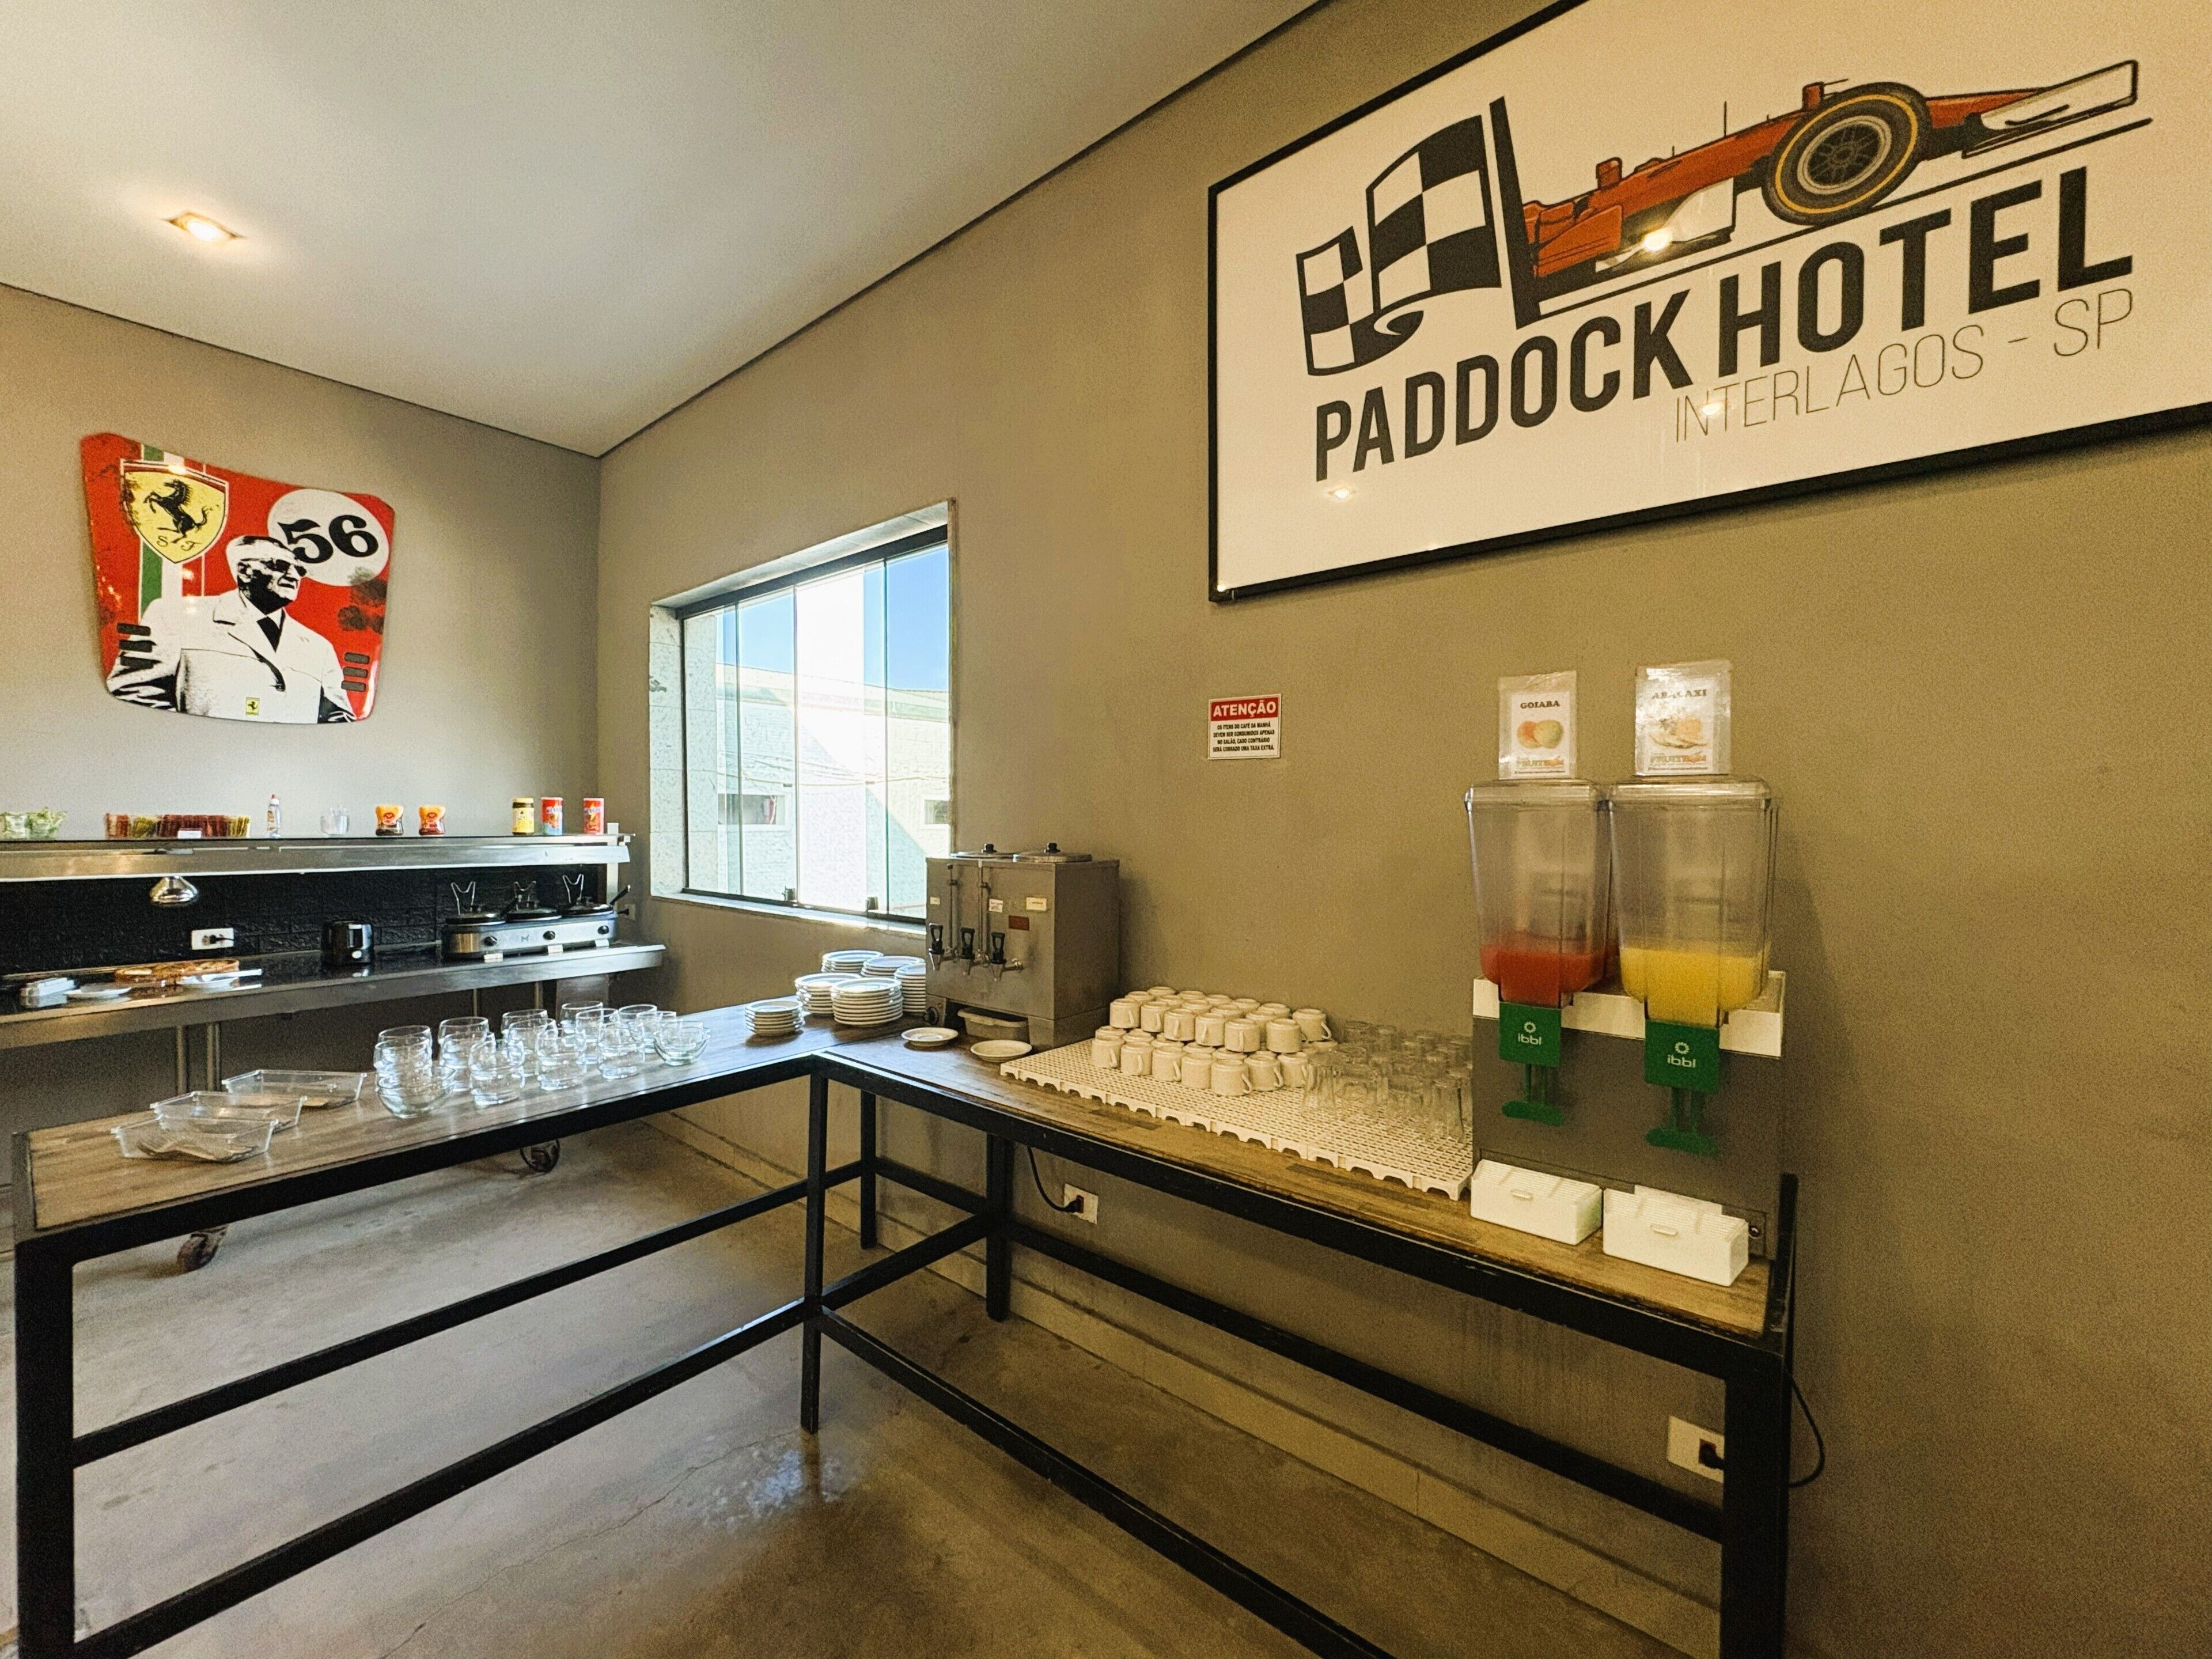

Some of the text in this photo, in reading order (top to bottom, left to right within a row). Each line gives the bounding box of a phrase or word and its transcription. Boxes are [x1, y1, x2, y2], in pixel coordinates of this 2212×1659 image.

[1316, 166, 2133, 482] PADDOCK HOTEL
[1676, 324, 1984, 443] INTERLAGOS
[2054, 288, 2133, 357] SP
[277, 514, 379, 564] 56
[1213, 699, 1277, 718] ATENÇÃO
[1520, 700, 1560, 709] GOIABA
[1517, 1033, 1542, 1045] ibbl
[1666, 1054, 1696, 1068] ibbl
